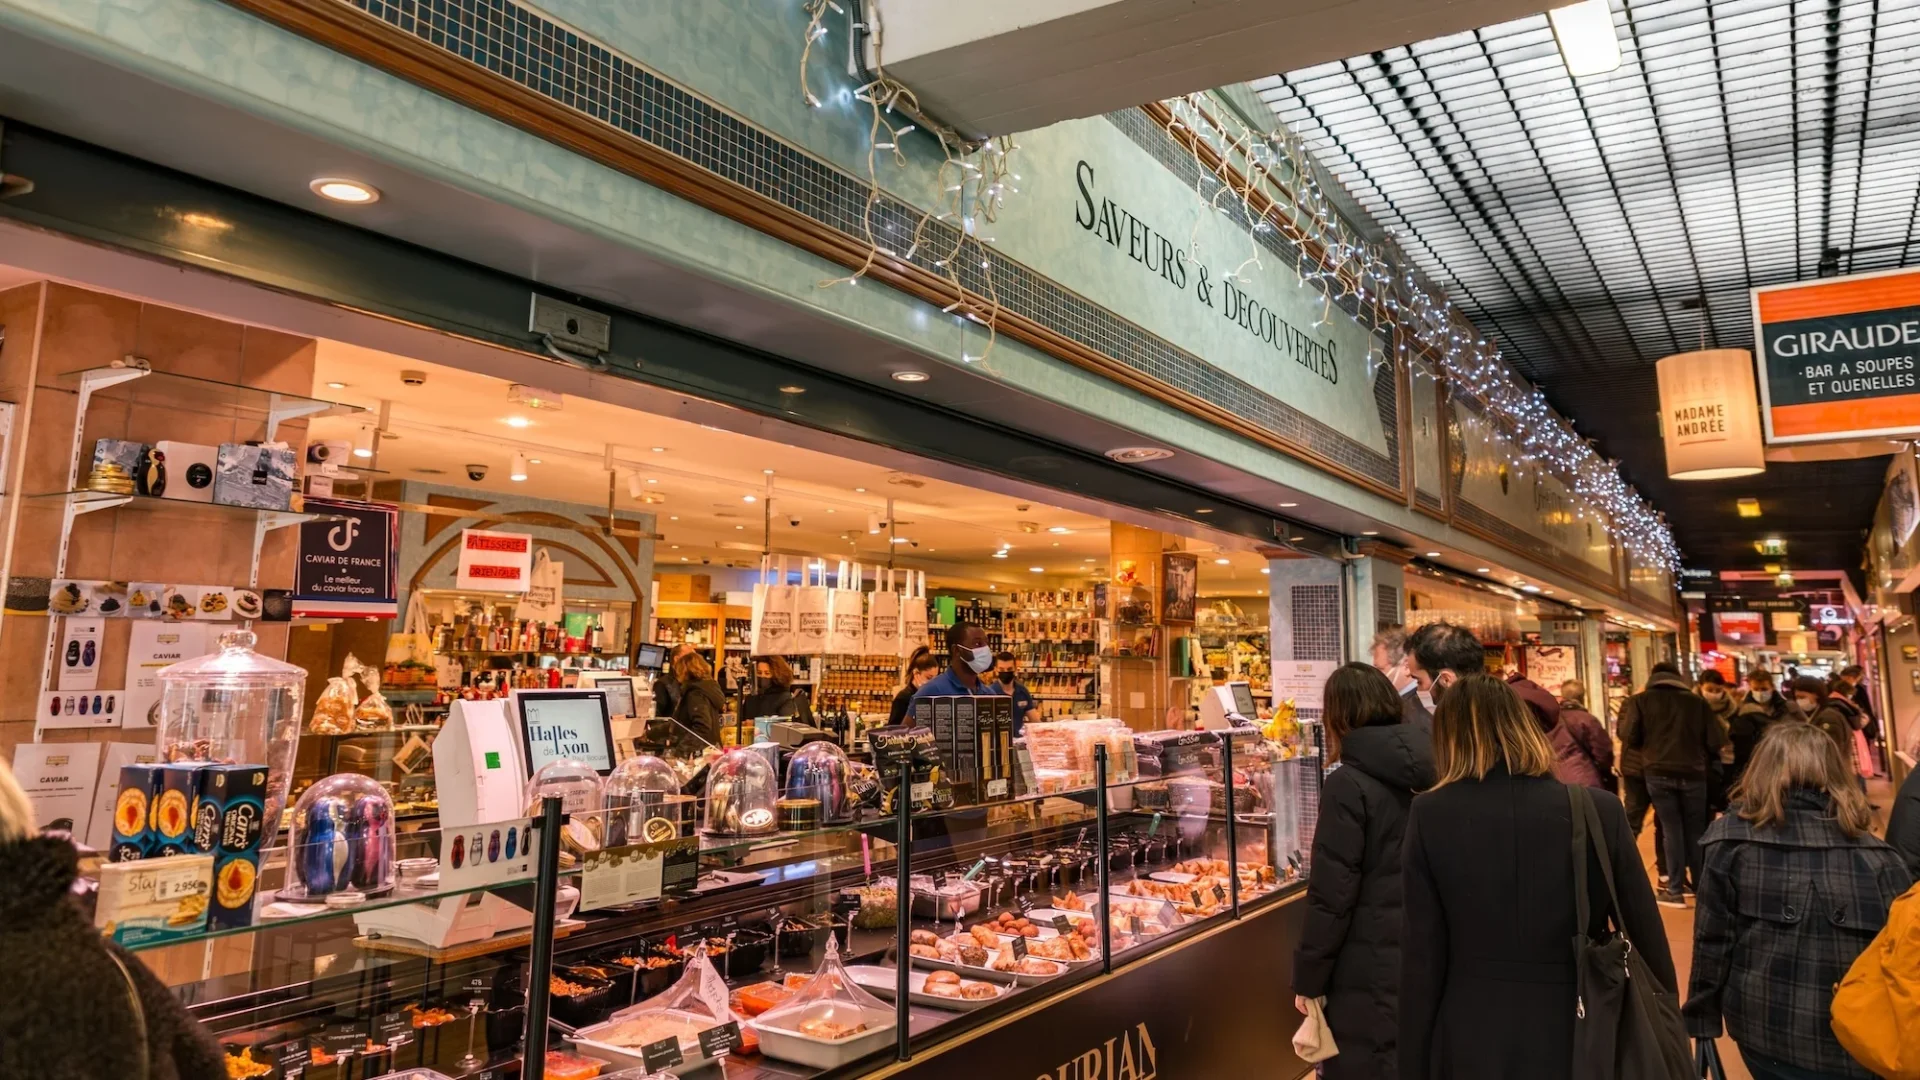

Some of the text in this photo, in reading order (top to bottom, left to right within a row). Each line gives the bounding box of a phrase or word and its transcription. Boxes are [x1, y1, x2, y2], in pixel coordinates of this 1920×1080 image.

[1197, 265, 1213, 308] &
[1805, 355, 1914, 379] BAR A SOUPES
[1808, 373, 1915, 395] ET QUENELLES
[1675, 404, 1724, 422] MADAME
[1677, 418, 1725, 437] ANDRÉE
[305, 554, 381, 567] CAVIAR DE FRANCE
[324, 575, 333, 583] Le
[529, 725, 578, 742] Halles
[543, 742, 590, 758] de Lyon
[40, 776, 69, 784] CAVIAR
